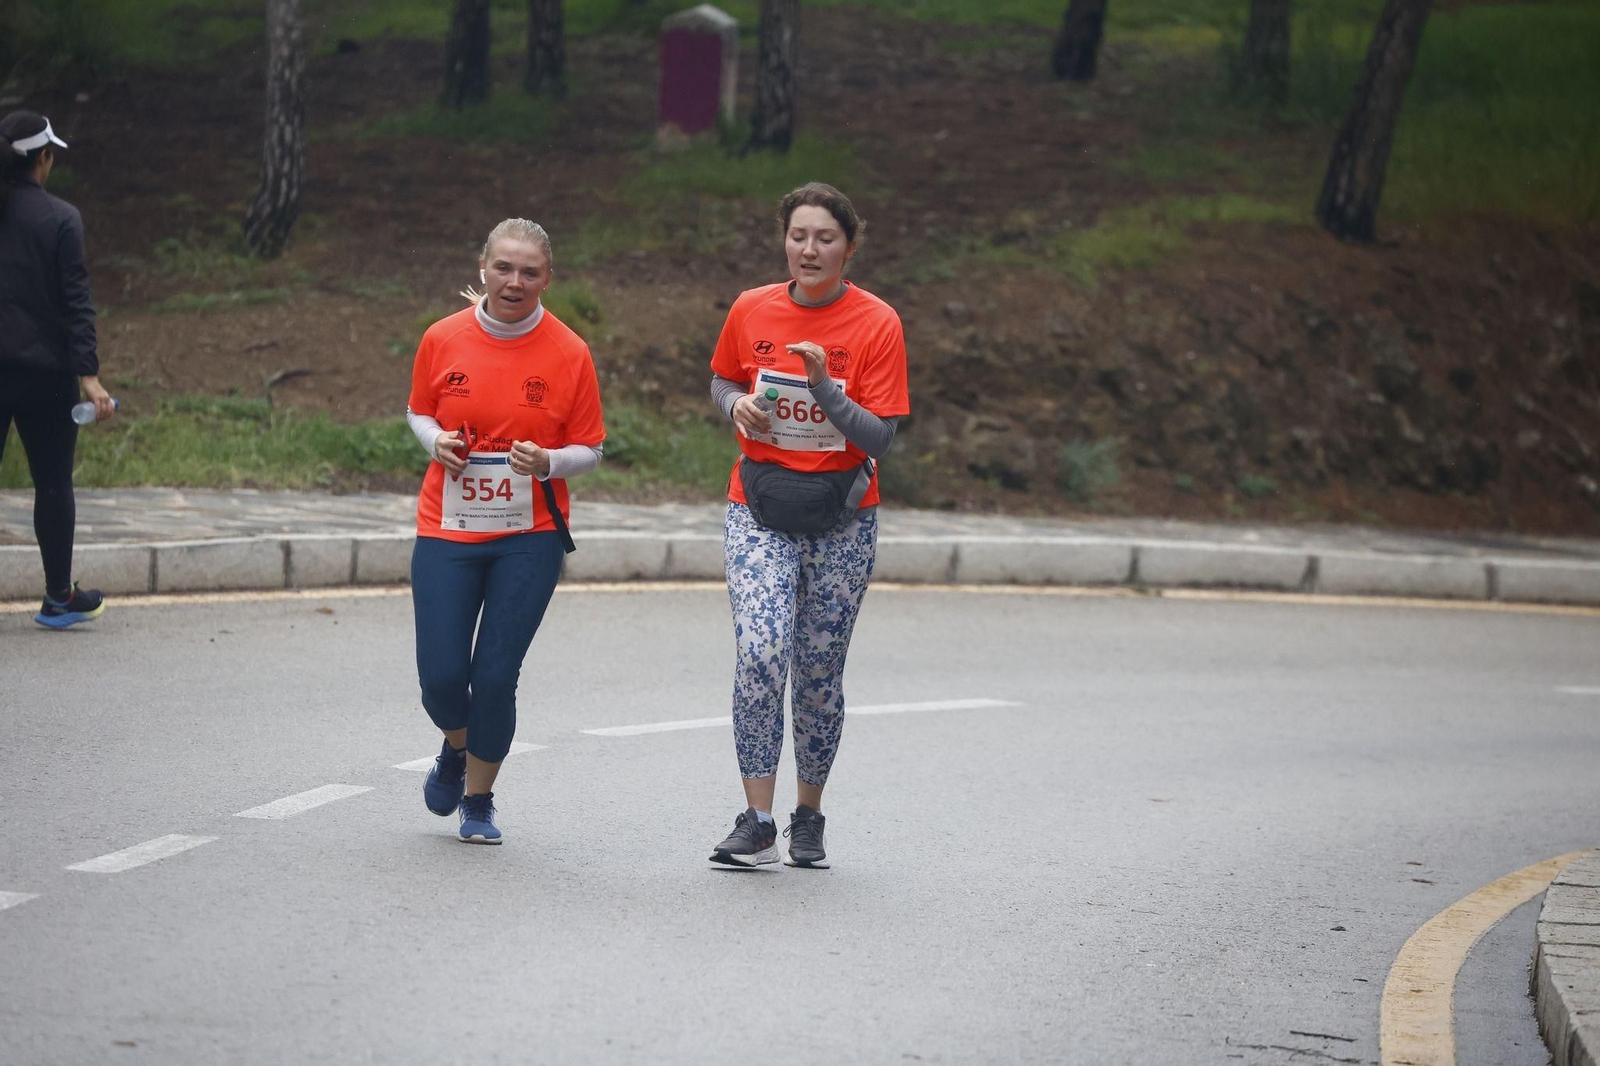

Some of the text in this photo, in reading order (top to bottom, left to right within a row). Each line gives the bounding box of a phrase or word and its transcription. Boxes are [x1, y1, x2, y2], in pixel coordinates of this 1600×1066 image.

[776, 397, 827, 424] 666
[478, 443, 512, 452] de Mál
[482, 433, 513, 446] Ciudad
[462, 477, 514, 502] 554
